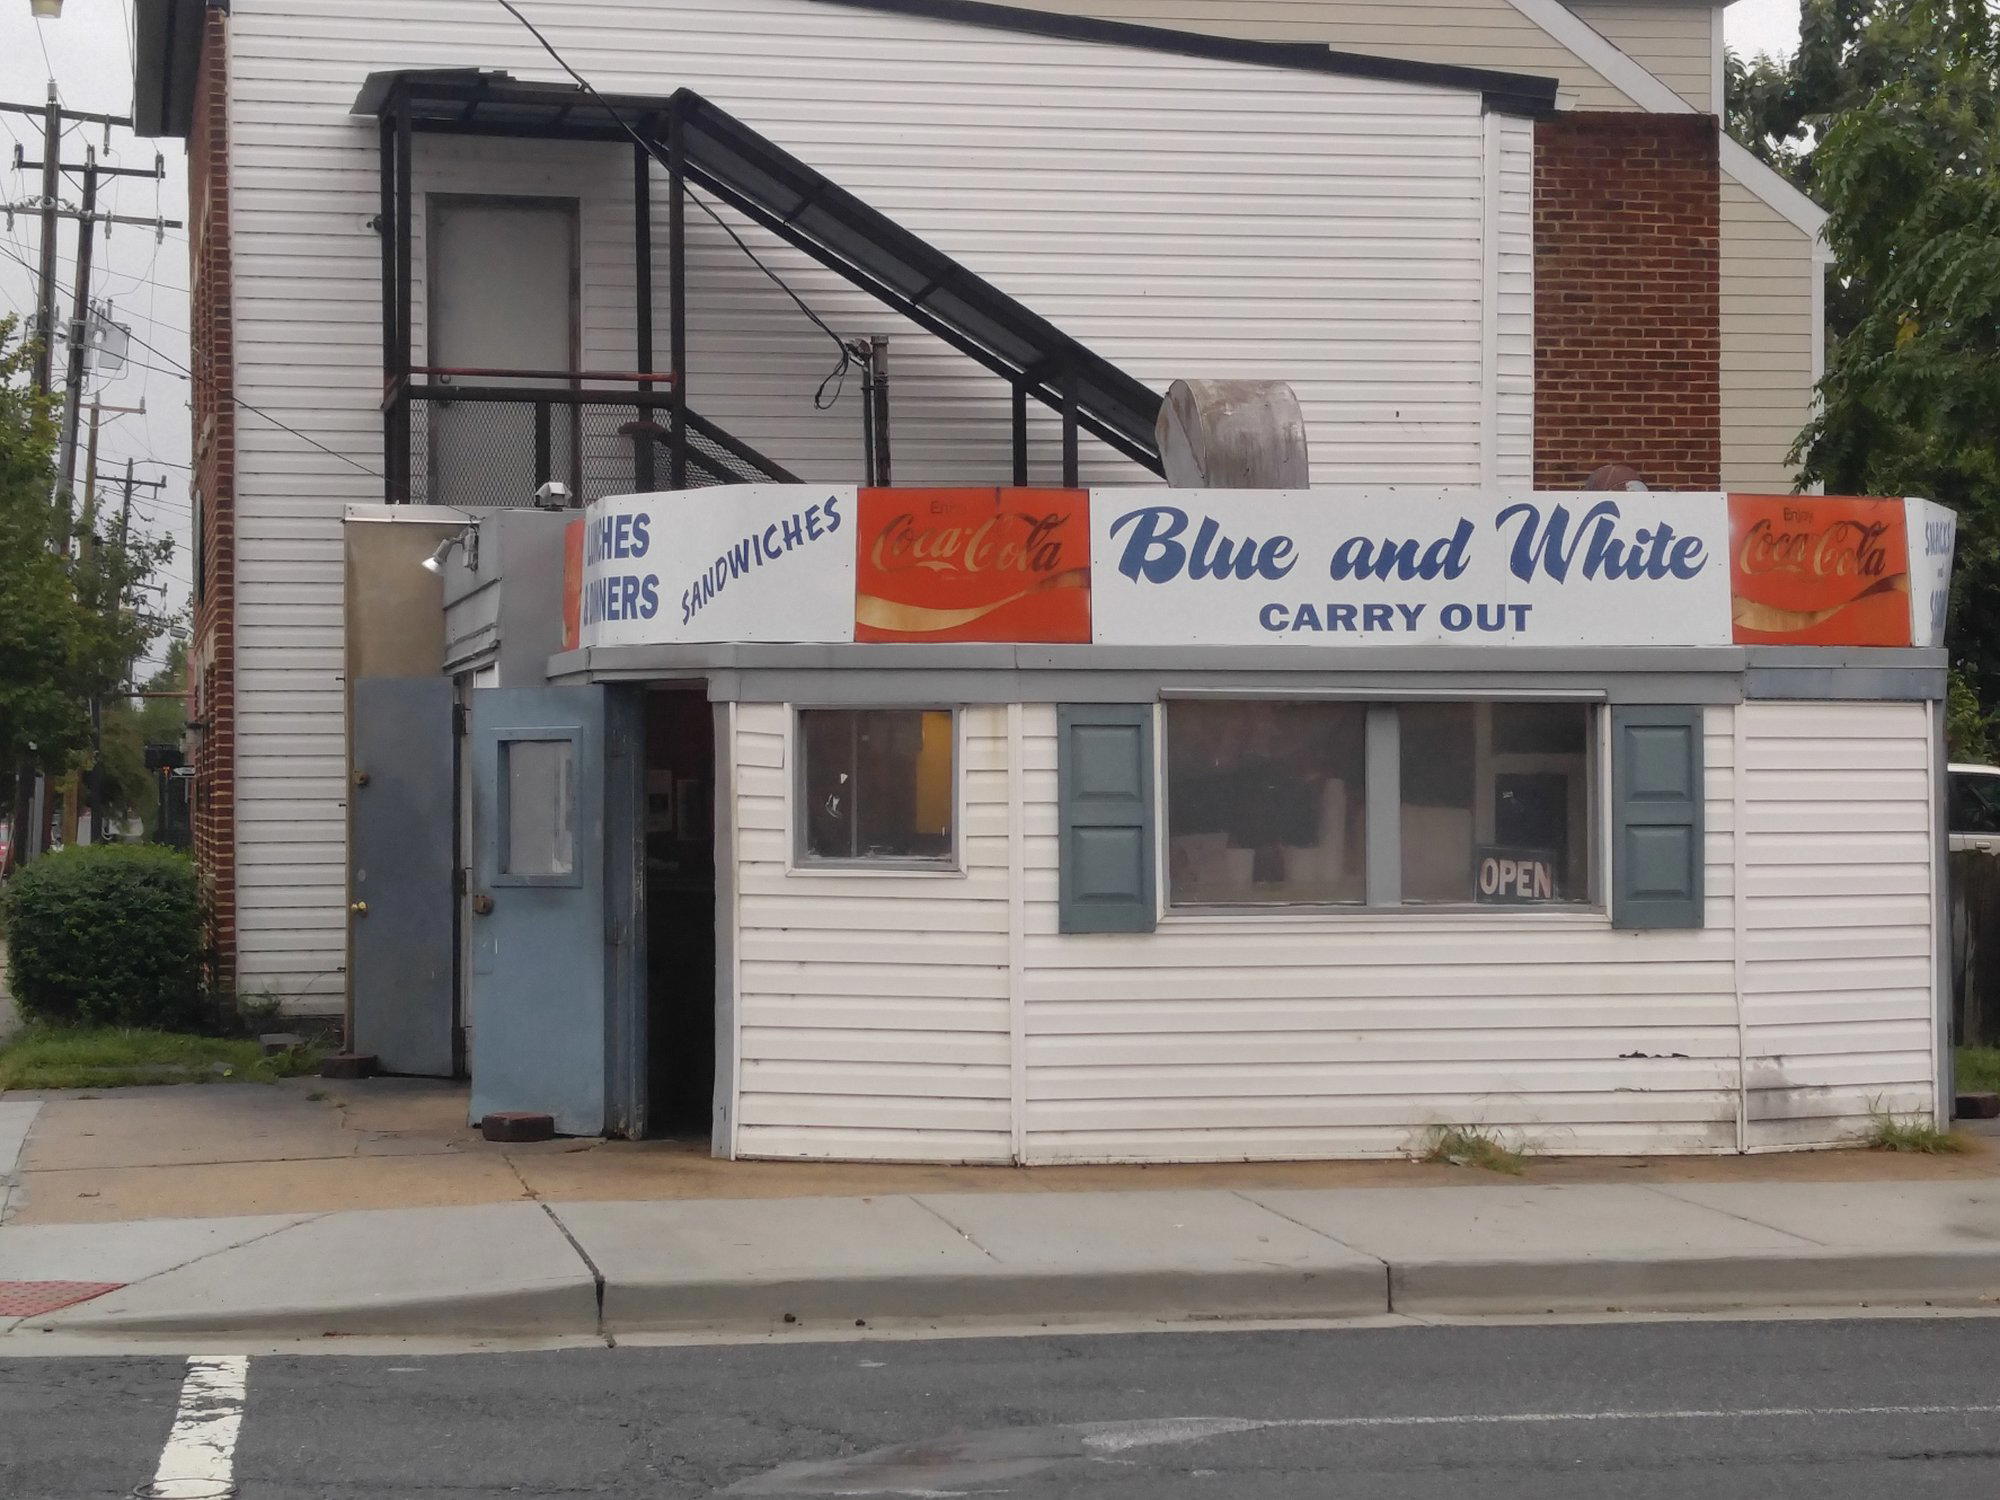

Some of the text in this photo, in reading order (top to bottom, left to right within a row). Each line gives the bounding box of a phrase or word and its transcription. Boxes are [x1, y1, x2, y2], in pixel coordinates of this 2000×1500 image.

[681, 495, 841, 625] SANDWICHES
[1109, 500, 1709, 584] Blue and White
[1258, 602, 1532, 632] CARRY OUT
[1480, 857, 1553, 898] OPEN
